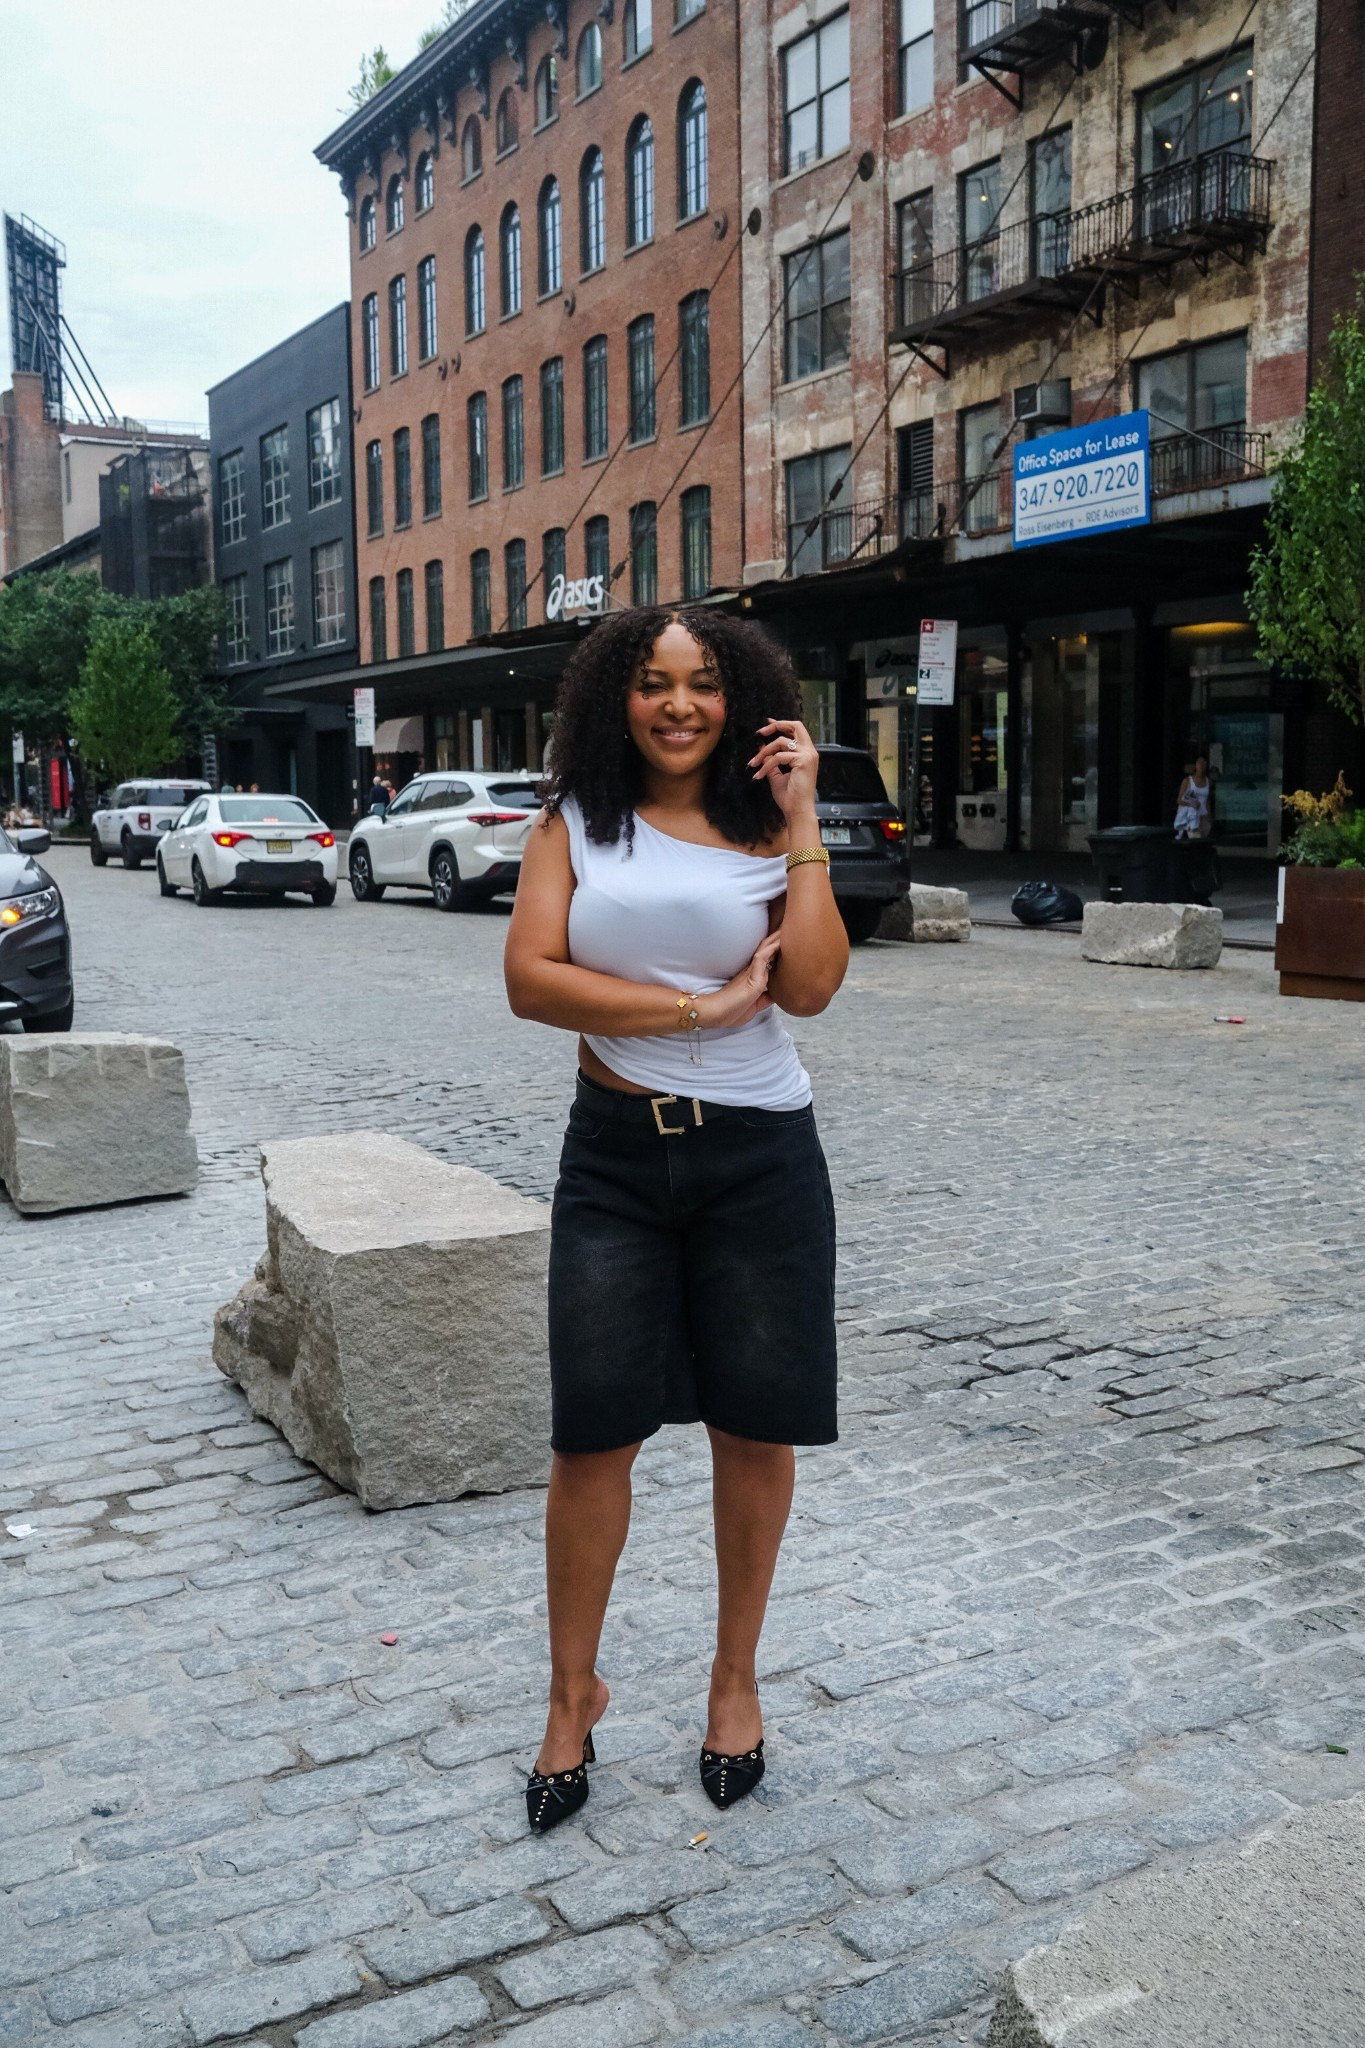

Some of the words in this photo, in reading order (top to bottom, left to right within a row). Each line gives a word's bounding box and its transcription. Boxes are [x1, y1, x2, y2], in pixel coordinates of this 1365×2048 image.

[1018, 453, 1048, 473] Office
[1049, 445, 1083, 467] Space
[1085, 439, 1102, 456] for
[1105, 431, 1139, 451] Lease
[1019, 461, 1139, 512] 347.920.7220
[1018, 524, 1036, 537] Ross
[1037, 517, 1075, 533] Eisenberg
[1086, 509, 1102, 523] RDE
[1103, 504, 1140, 520] Advisors
